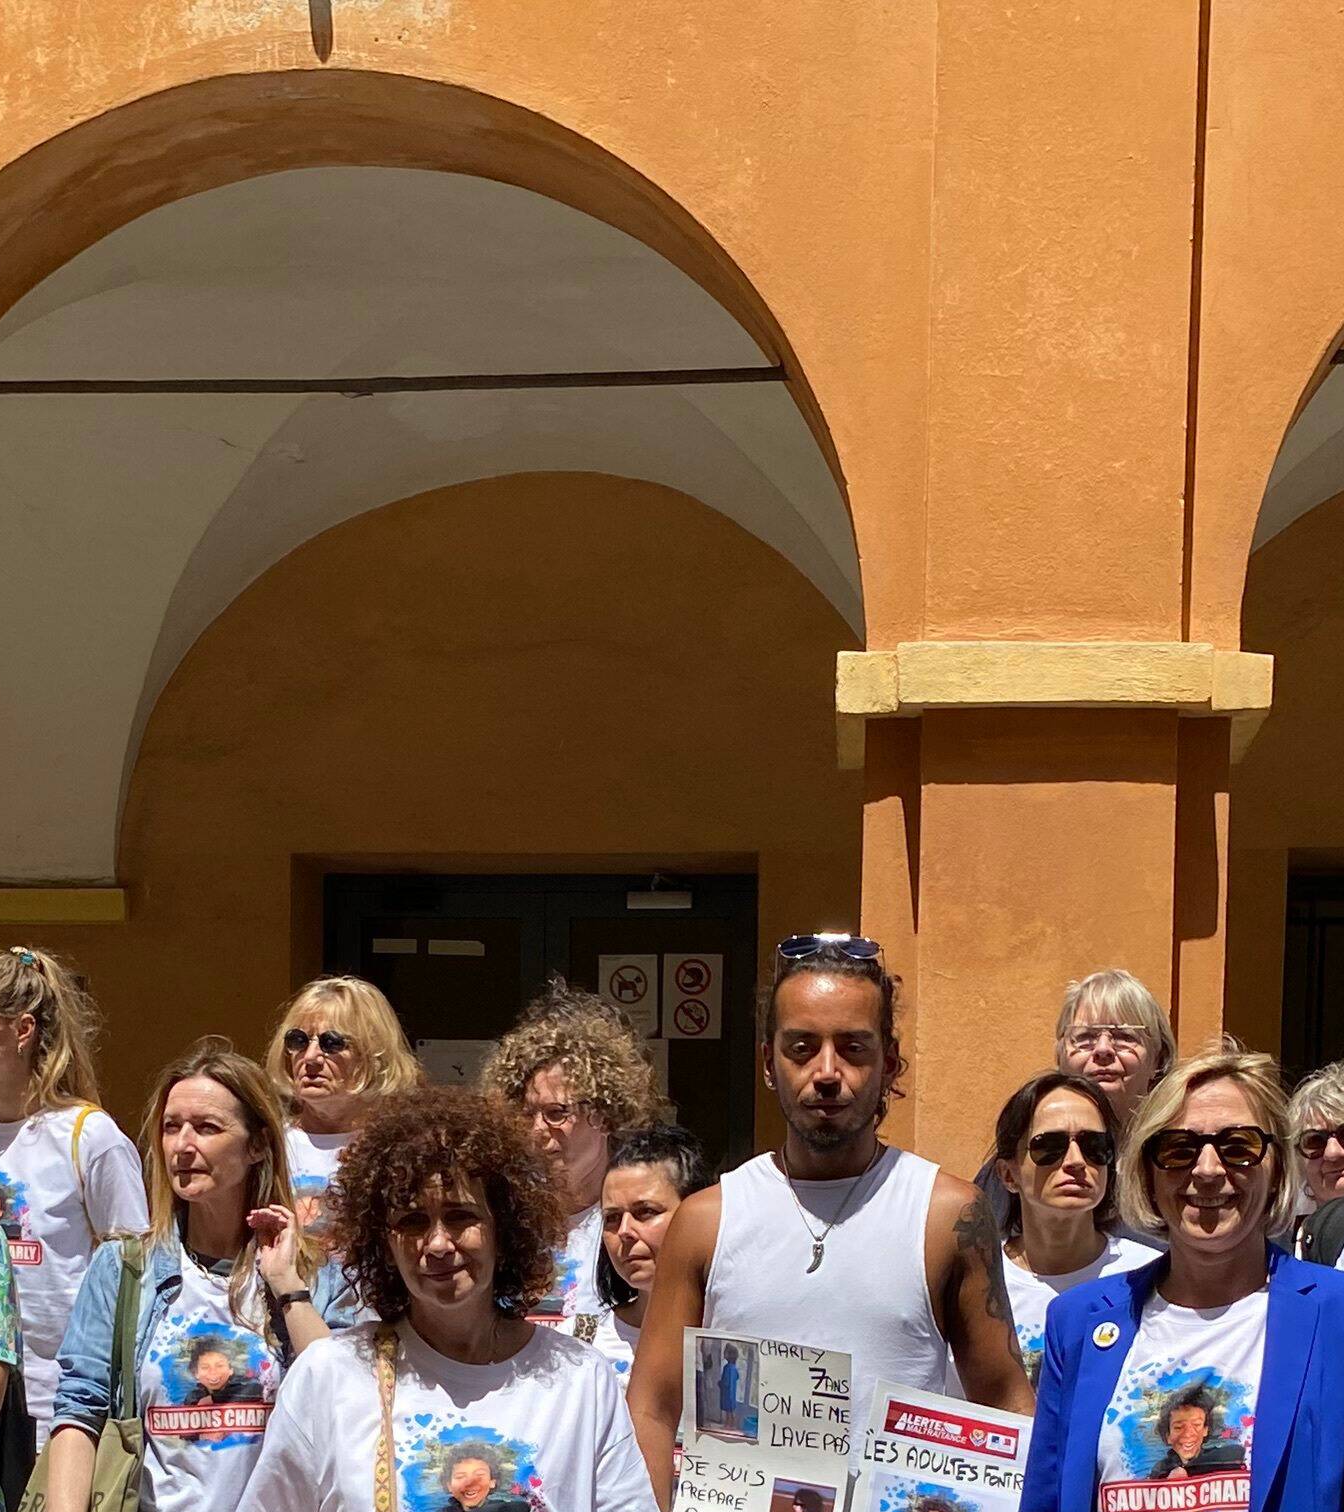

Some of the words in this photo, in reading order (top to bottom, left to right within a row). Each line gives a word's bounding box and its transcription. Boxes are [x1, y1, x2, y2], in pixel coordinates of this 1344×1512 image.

[8, 1244, 37, 1260] ARLY
[759, 1338, 826, 1364] CHARLY
[152, 1409, 222, 1430] SAUVONS
[223, 1408, 266, 1427] CHAR
[802, 1399, 824, 1420] NE
[898, 1412, 944, 1431] ALERTE
[770, 1423, 820, 1449] LAVE
[906, 1423, 968, 1445] MALTRAITANCE
[906, 1446, 979, 1482] ADULTES
[1107, 1484, 1197, 1512] SAUVONS
[1199, 1479, 1251, 1506] CHAR
